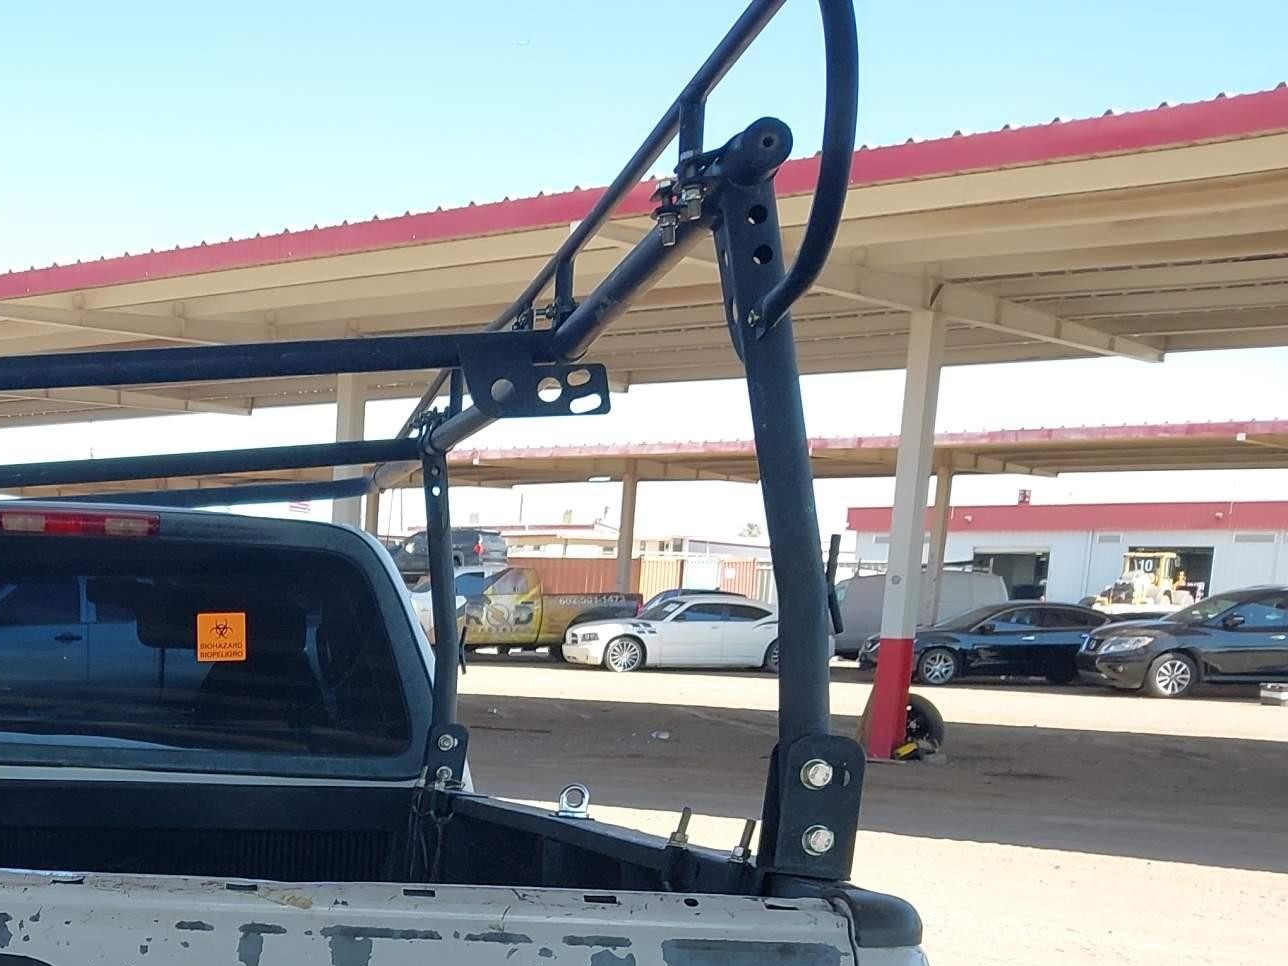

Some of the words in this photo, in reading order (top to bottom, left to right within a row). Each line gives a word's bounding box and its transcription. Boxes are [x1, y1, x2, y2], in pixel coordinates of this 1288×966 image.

[1138, 559, 1153, 573] 10
[200, 641, 243, 650] BIOHAZARD
[200, 650, 243, 659] BIOPELIGRO
